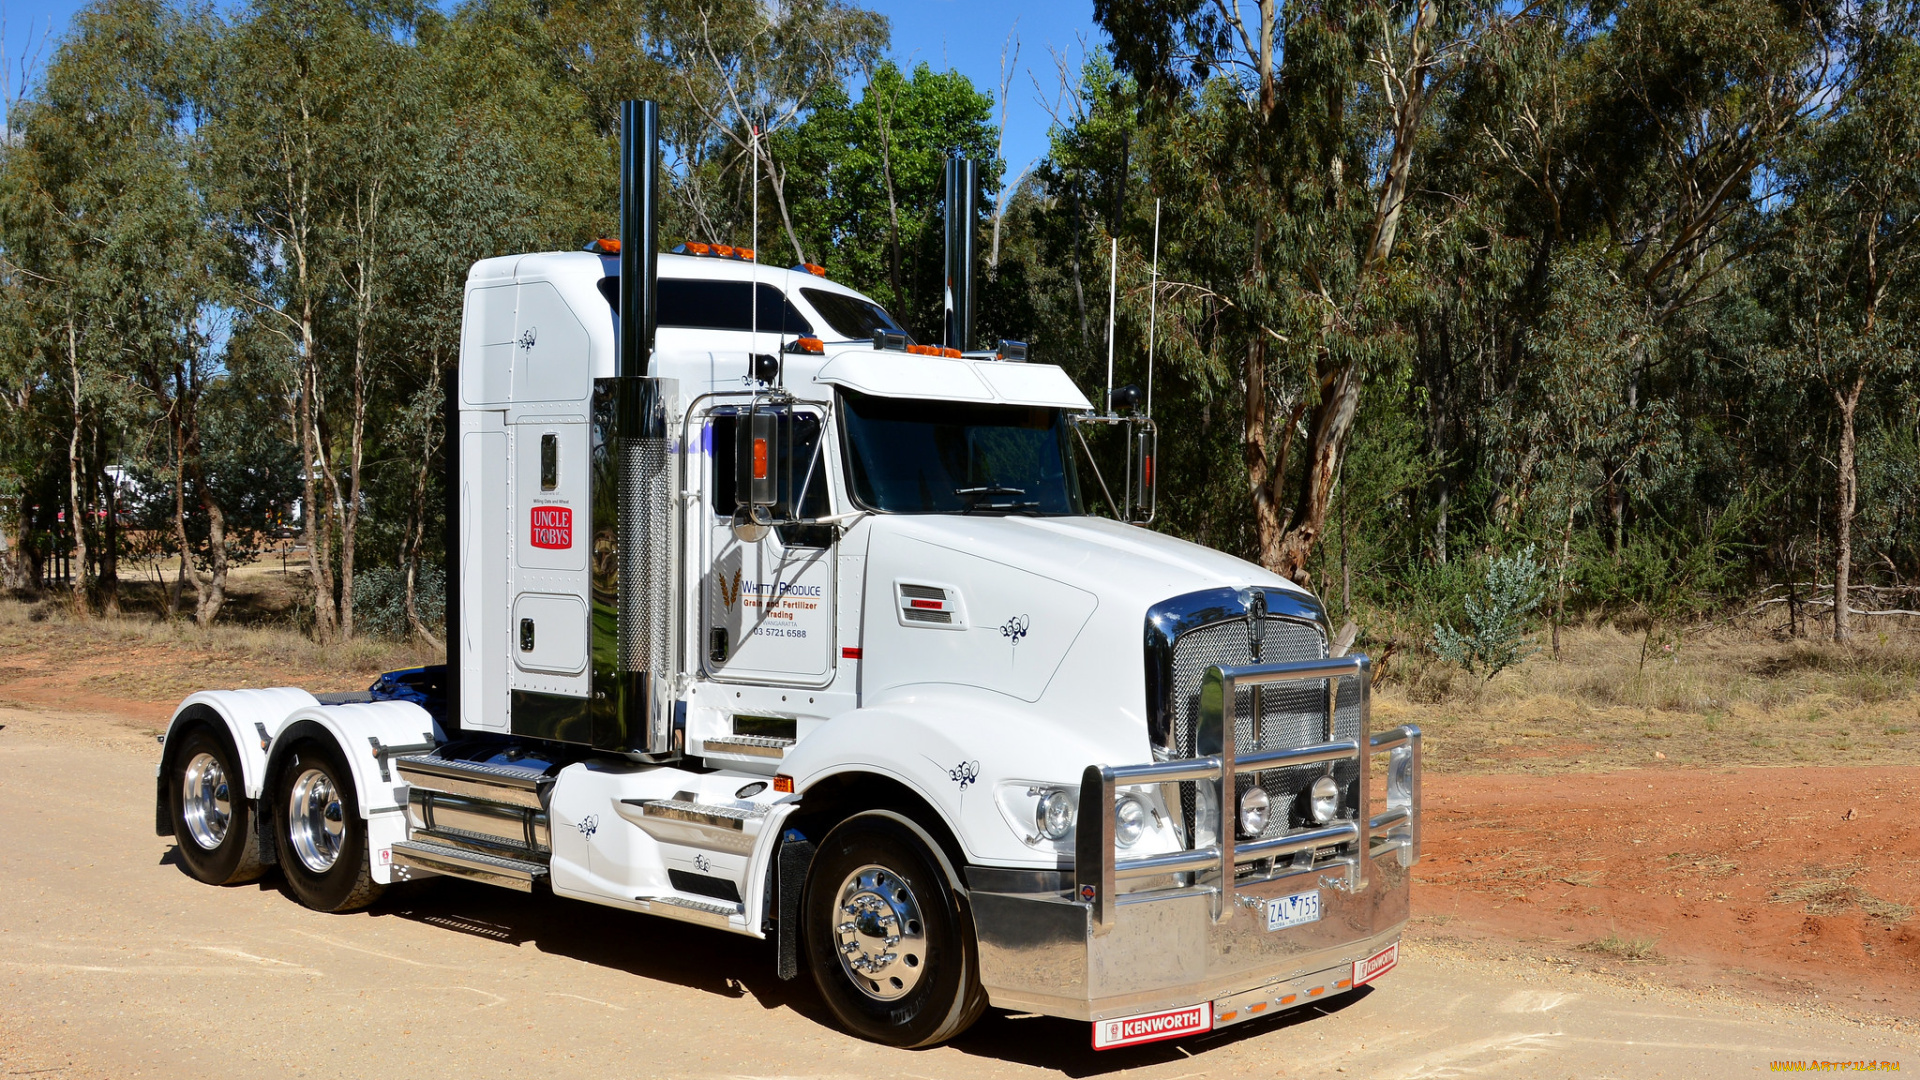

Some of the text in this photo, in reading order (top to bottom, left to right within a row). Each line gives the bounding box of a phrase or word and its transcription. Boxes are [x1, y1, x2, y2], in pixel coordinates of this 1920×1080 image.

[534, 511, 569, 527] UNCLE
[534, 528, 569, 545] TOBYS
[742, 581, 820, 596] WHITTY PRODUCE
[743, 599, 818, 610] Grain and Fertilizer
[766, 610, 793, 620] Trading
[763, 620, 798, 628] WANGARATTA
[753, 628, 807, 638] 03 5721 6588
[1271, 895, 1317, 922] ZAL 755
[1368, 949, 1393, 974] KENWORTH
[1124, 1011, 1199, 1036] KENWORTH
